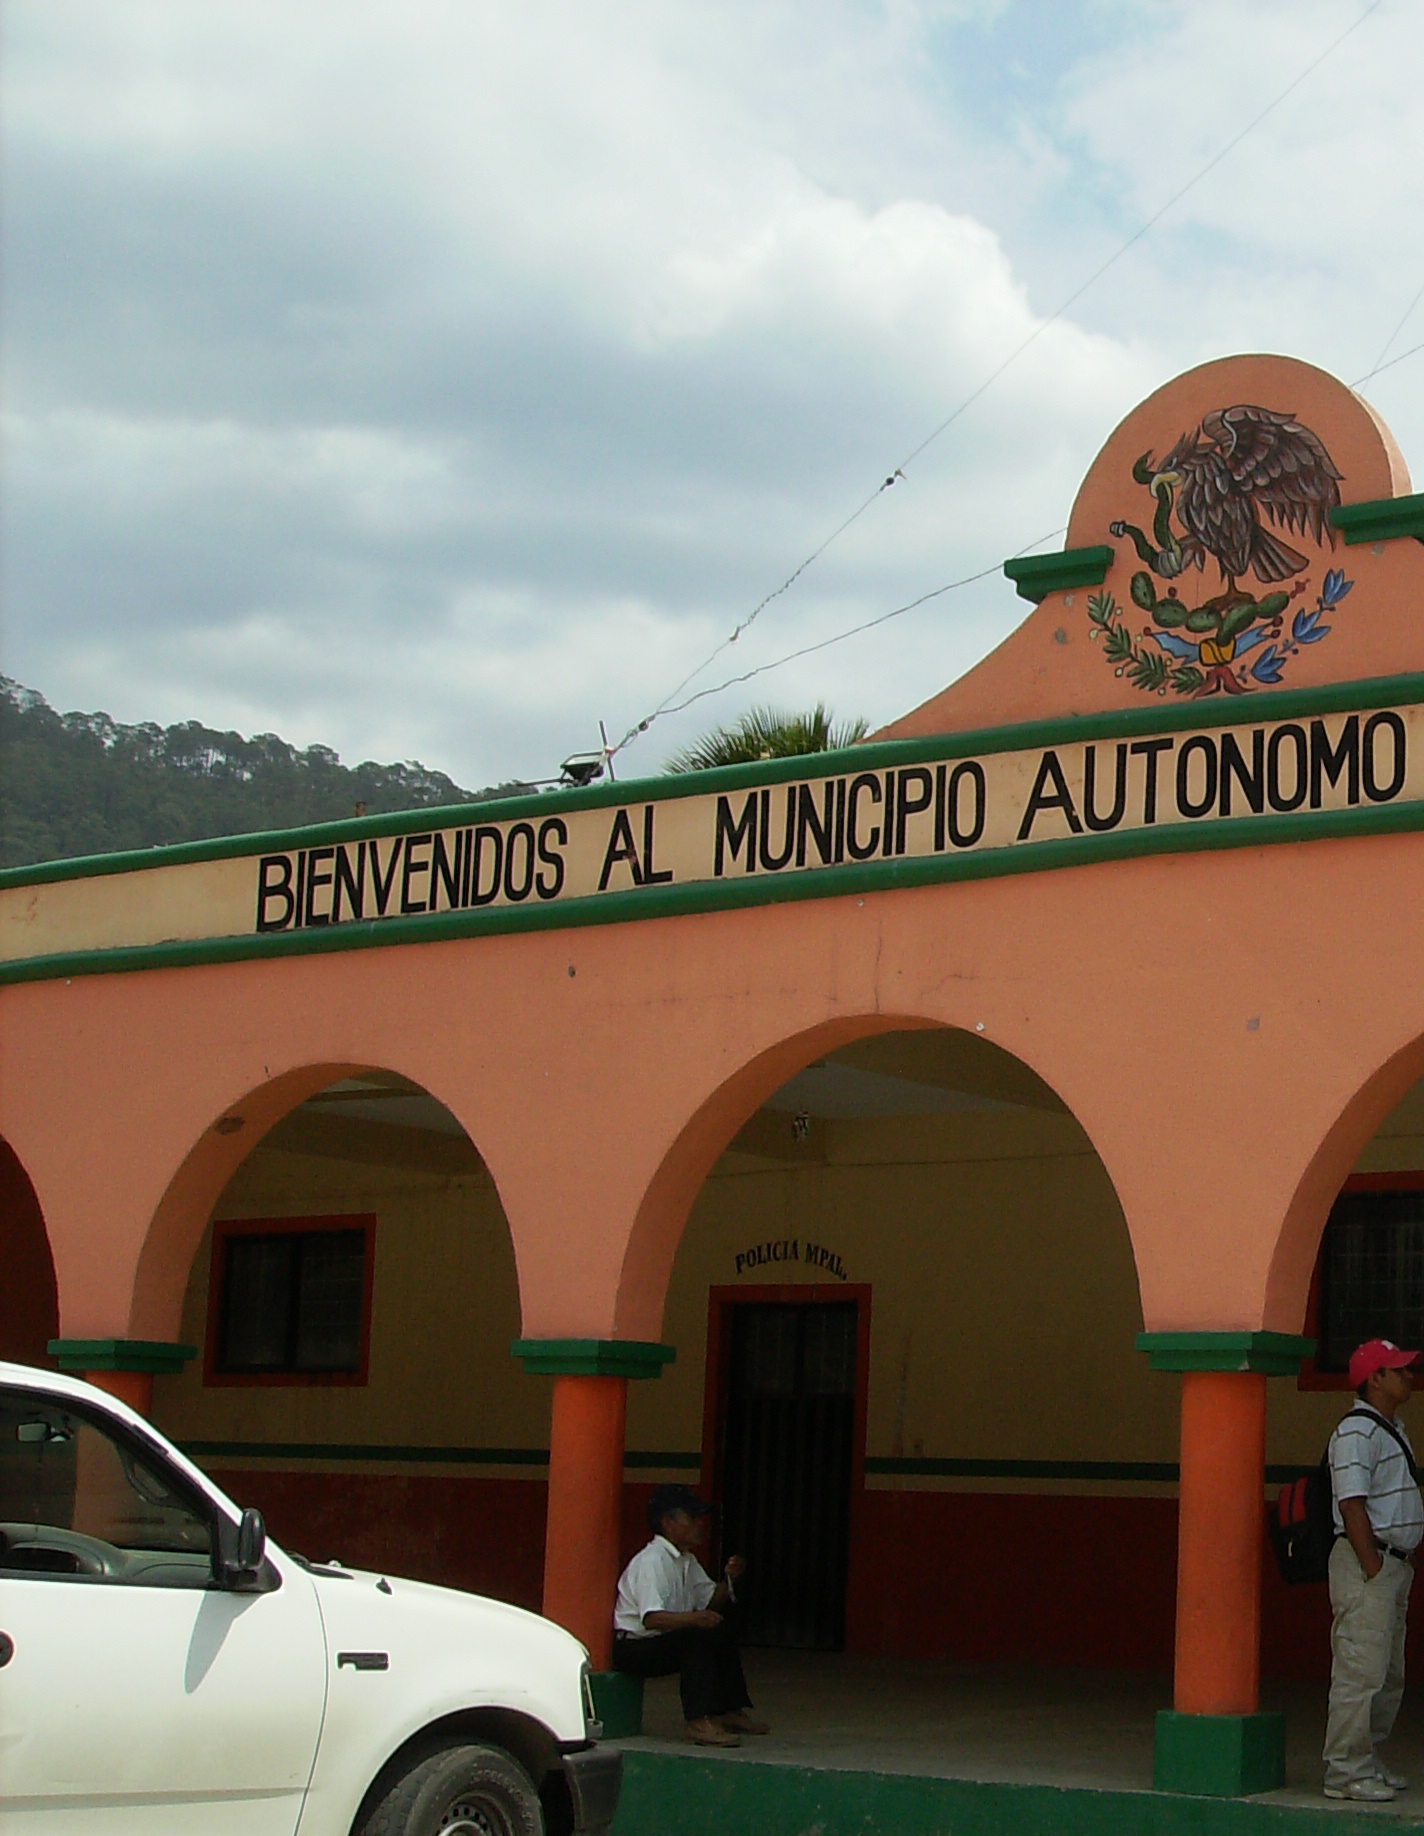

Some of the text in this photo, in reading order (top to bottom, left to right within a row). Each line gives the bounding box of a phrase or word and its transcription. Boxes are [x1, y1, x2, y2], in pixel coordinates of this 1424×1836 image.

[255, 817, 568, 934] BIENVENIDOS
[598, 804, 673, 892] AL
[713, 760, 986, 877] MUNICIPIO
[1016, 711, 1406, 841] AUTONOMO
[735, 1239, 800, 1275] POLICIA
